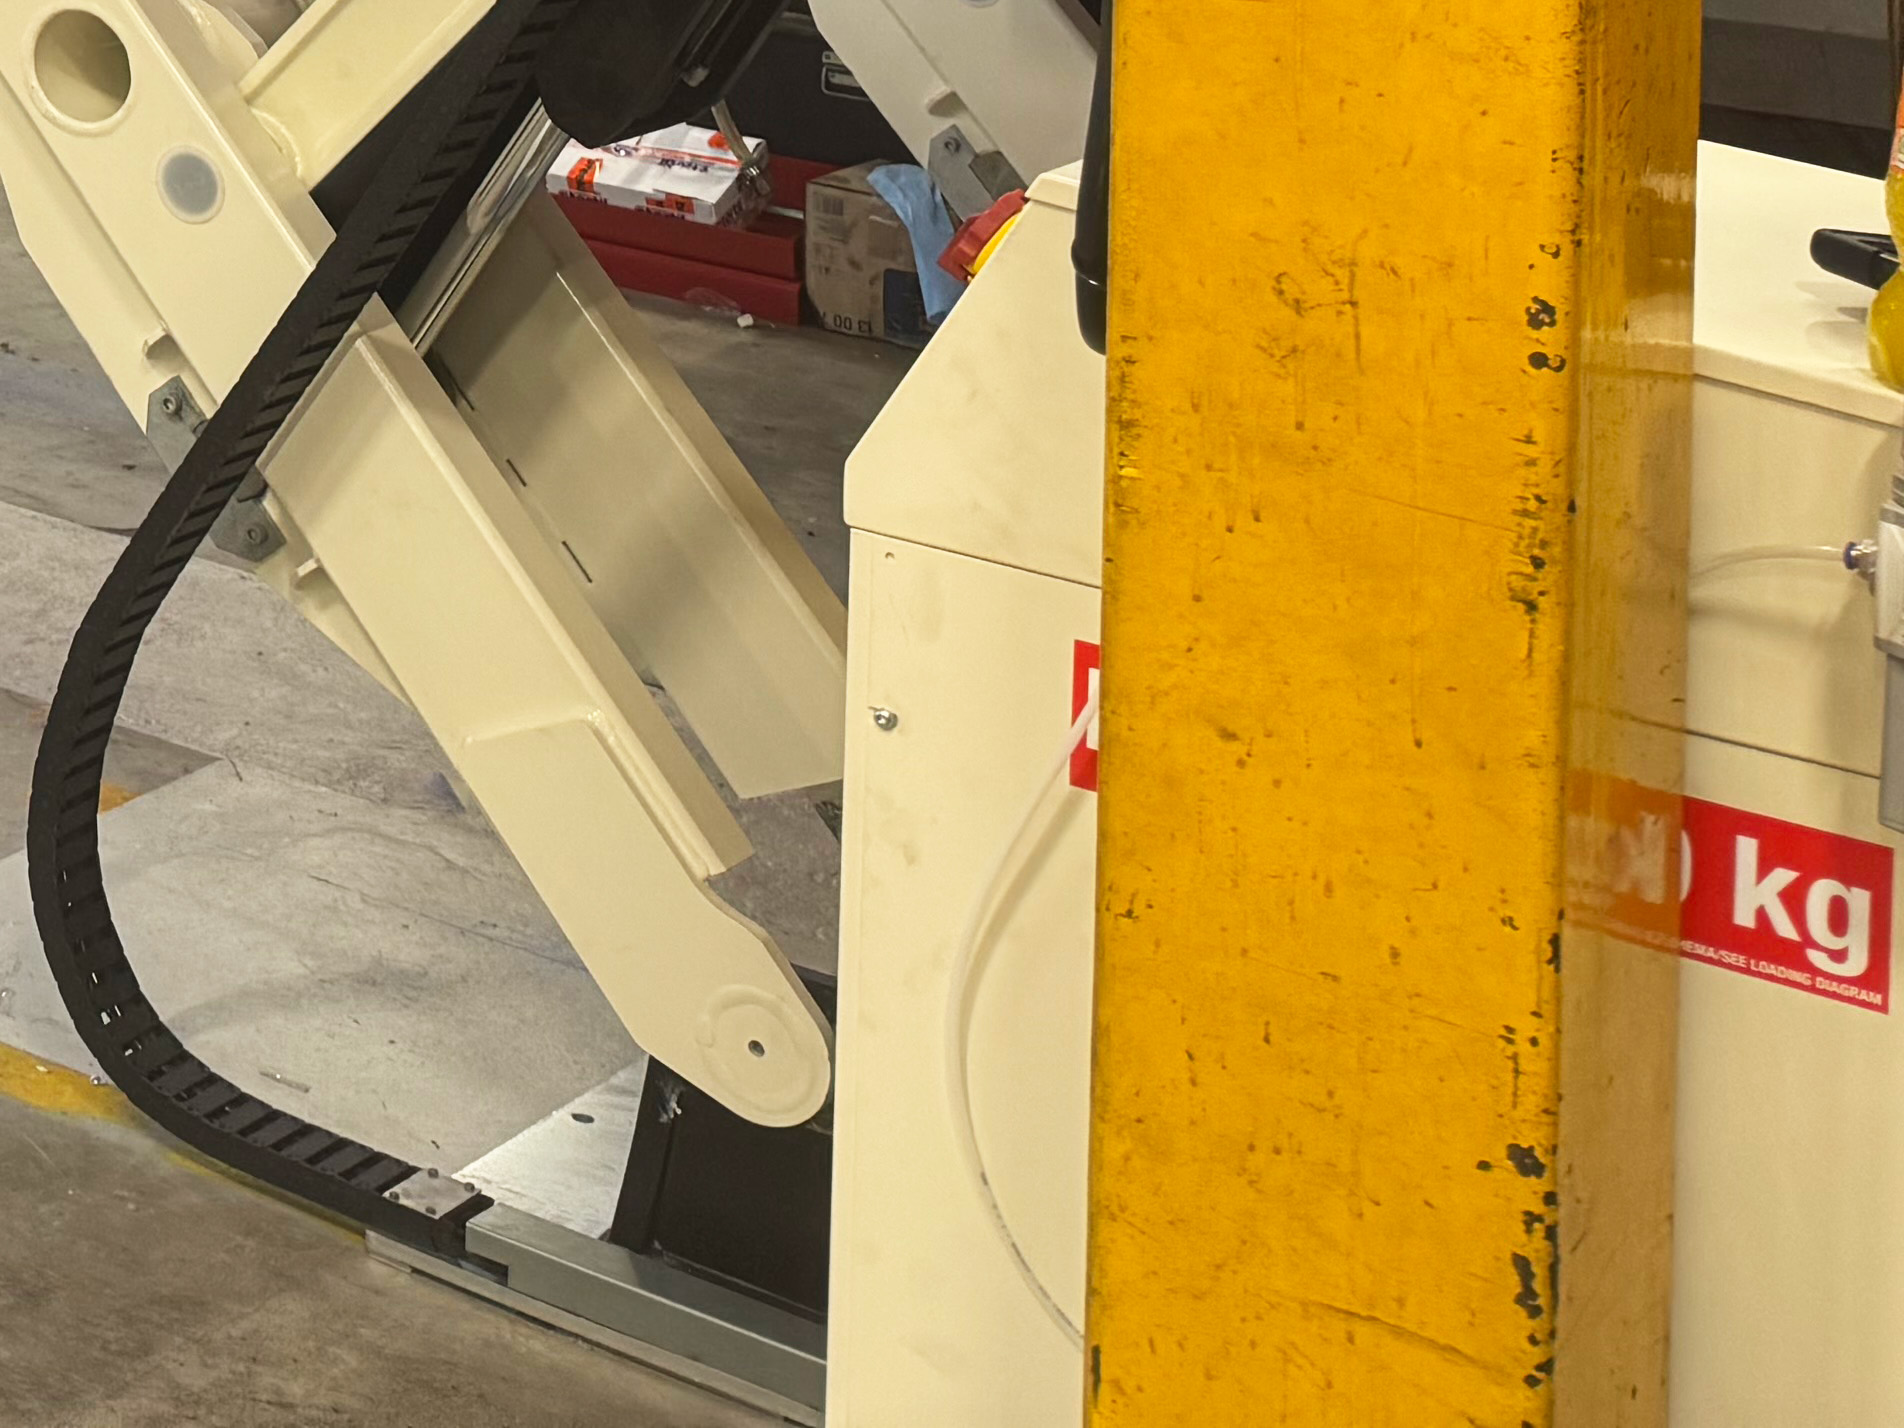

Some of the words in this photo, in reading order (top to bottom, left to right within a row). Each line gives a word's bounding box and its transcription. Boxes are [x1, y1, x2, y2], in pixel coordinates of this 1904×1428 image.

[1732, 834, 1871, 977] kg
[1750, 959, 1812, 986] LOADING
[1815, 976, 1882, 1005] DIAGRAM
